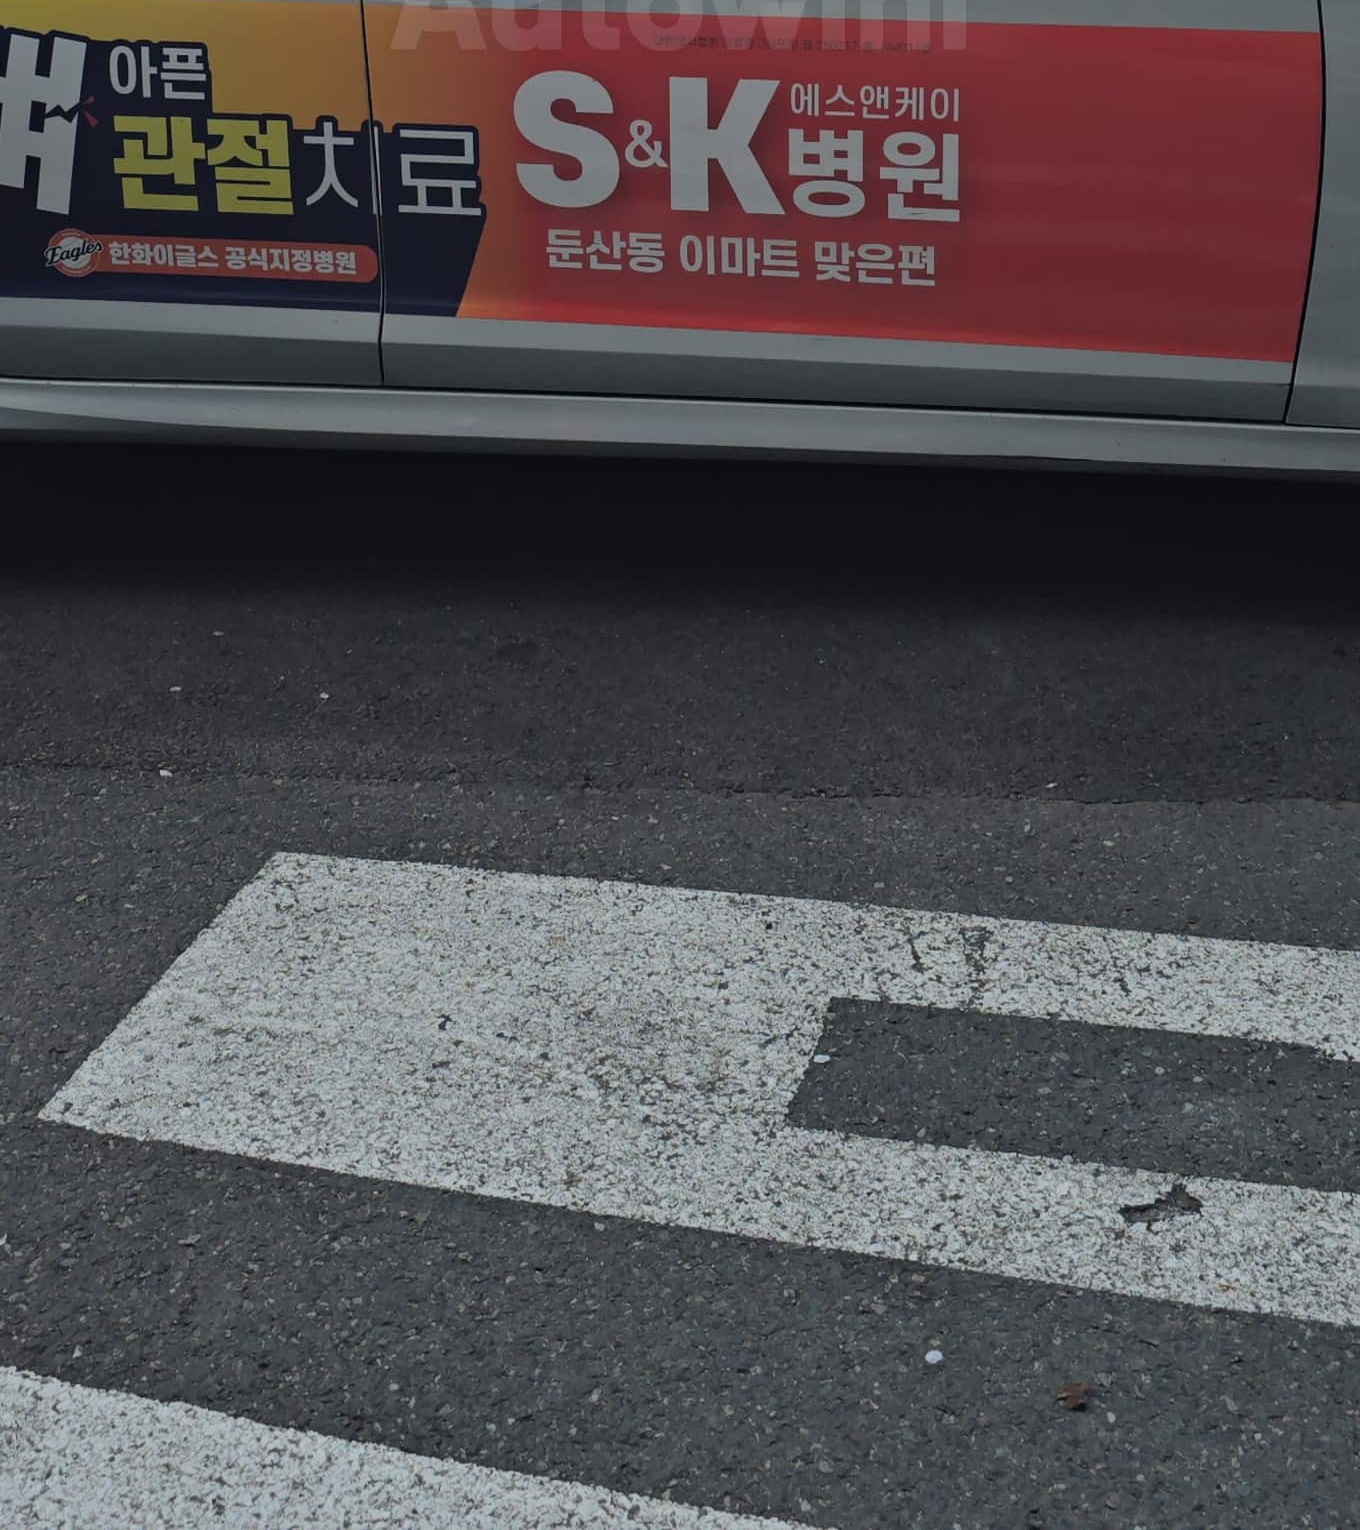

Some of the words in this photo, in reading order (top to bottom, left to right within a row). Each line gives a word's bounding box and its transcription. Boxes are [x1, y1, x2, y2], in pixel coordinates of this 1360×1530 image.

[110, 43, 209, 100] 아픈
[790, 83, 960, 123] 에스앤케이
[513, 69, 786, 214] S&K
[787, 129, 960, 222] 병원
[44, 238, 102, 267] Eagles
[109, 241, 219, 268] 한화이글스
[225, 246, 358, 275] 공식지정병원
[545, 228, 665, 272] 둔산동
[680, 233, 800, 277] 이마트
[814, 240, 937, 287] 맞은편
